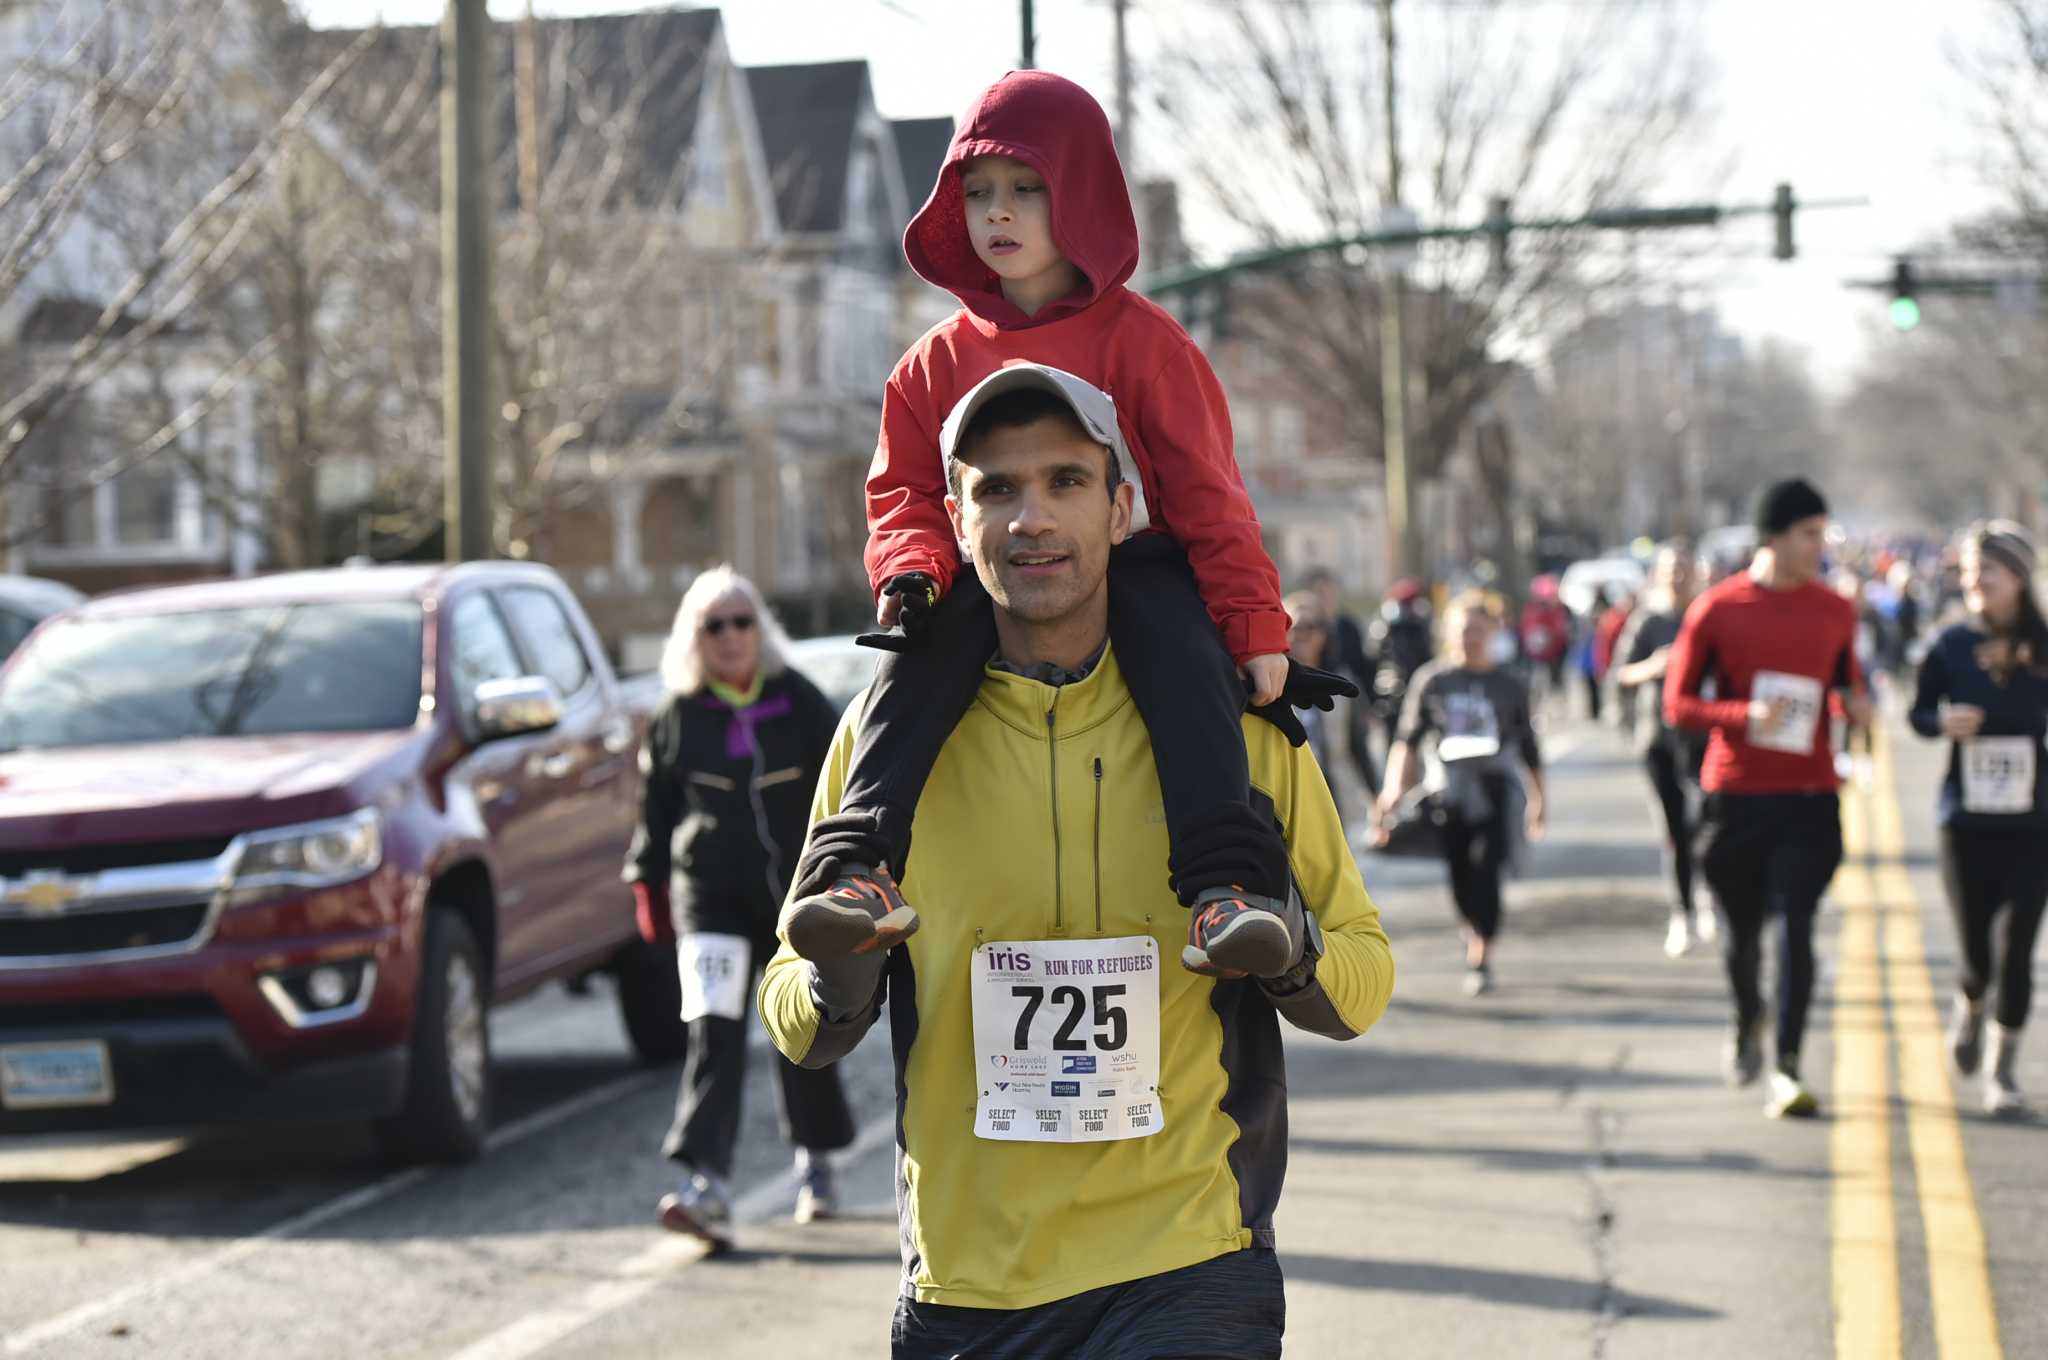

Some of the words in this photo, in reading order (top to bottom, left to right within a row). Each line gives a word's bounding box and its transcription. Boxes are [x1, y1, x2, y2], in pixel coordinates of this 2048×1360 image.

[988, 946, 1031, 971] iris
[1044, 960, 1069, 976] RUN
[1072, 959, 1094, 975] FOR
[1098, 955, 1153, 974] REFUGEES
[1011, 984, 1128, 1050] 725
[1009, 1055, 1047, 1065] Griswold
[1111, 1052, 1137, 1062] wshu
[988, 1109, 1016, 1120] SELECT
[1036, 1109, 1062, 1120] SELECT
[1079, 1109, 1108, 1120] SELECT
[1127, 1103, 1152, 1116] SELECT
[992, 1121, 1010, 1131] FOOD
[1040, 1121, 1058, 1132] FOOD
[1085, 1121, 1103, 1132] FOOD
[1132, 1116, 1149, 1127] FOOD
